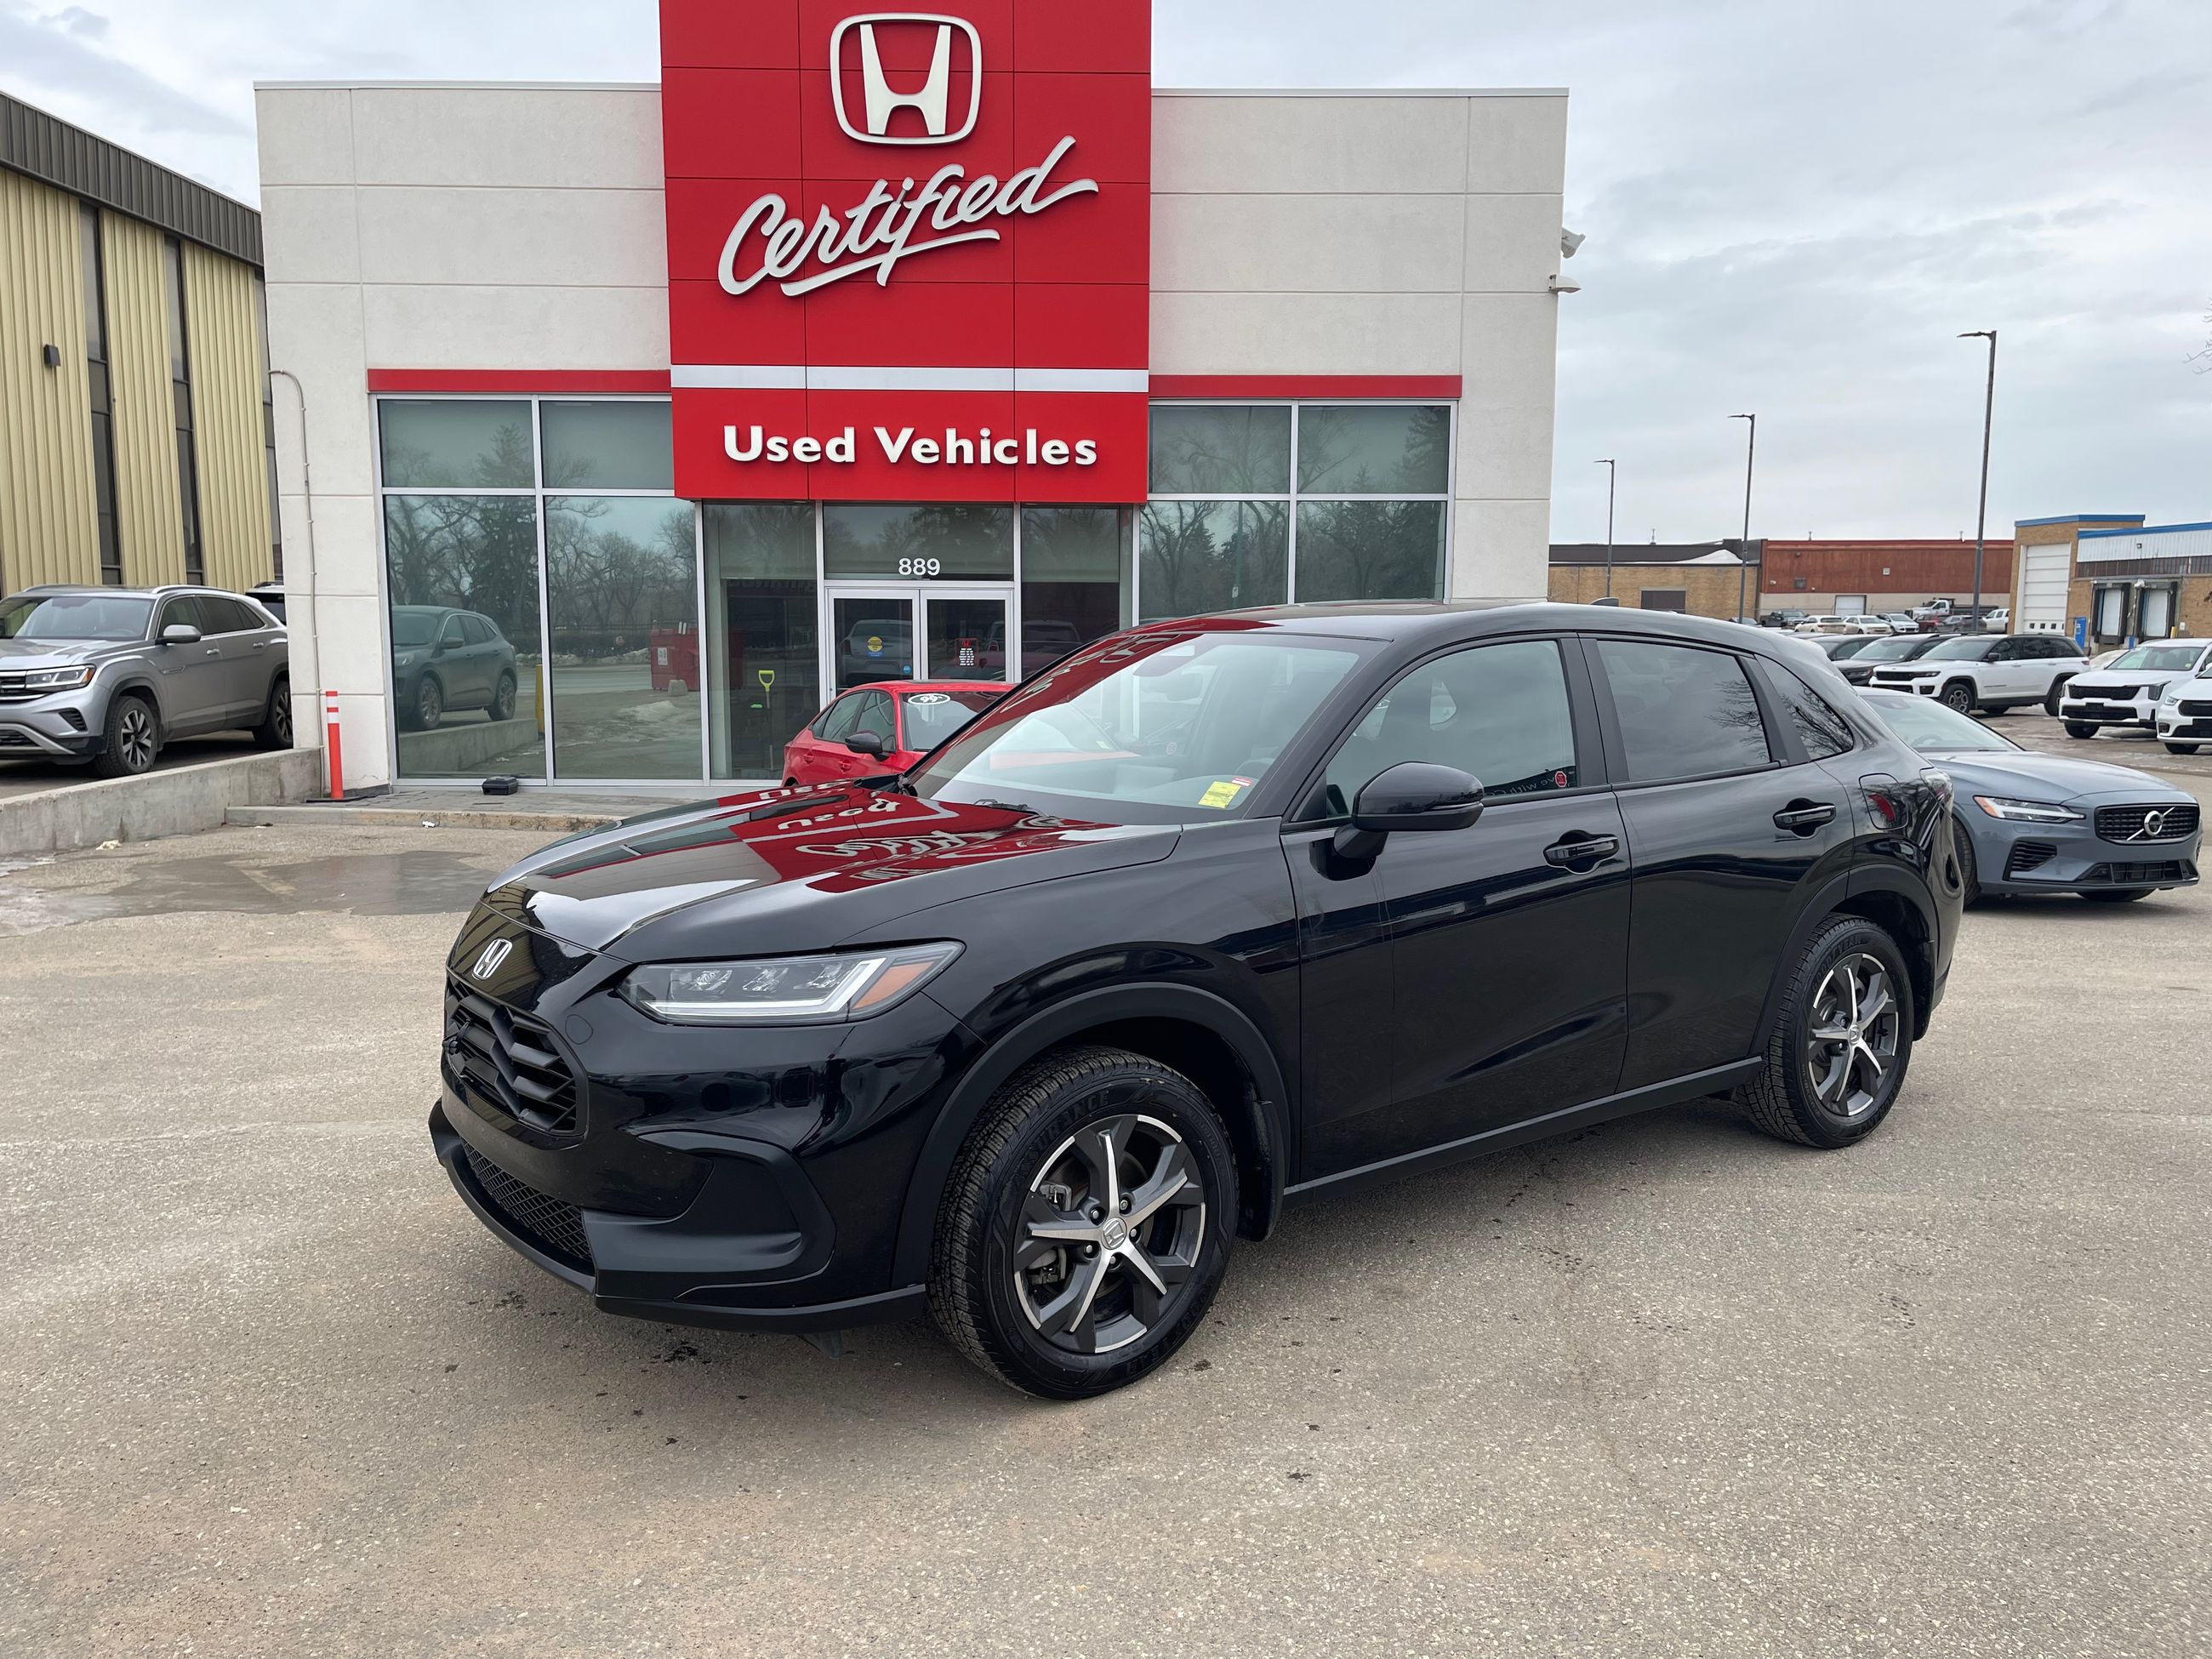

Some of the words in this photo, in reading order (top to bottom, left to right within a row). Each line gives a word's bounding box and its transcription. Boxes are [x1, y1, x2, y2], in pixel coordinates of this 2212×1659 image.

[718, 135, 1099, 296] Certified
[723, 425, 856, 463] Used
[873, 427, 1097, 465] Vehicles
[898, 557, 940, 575] 889
